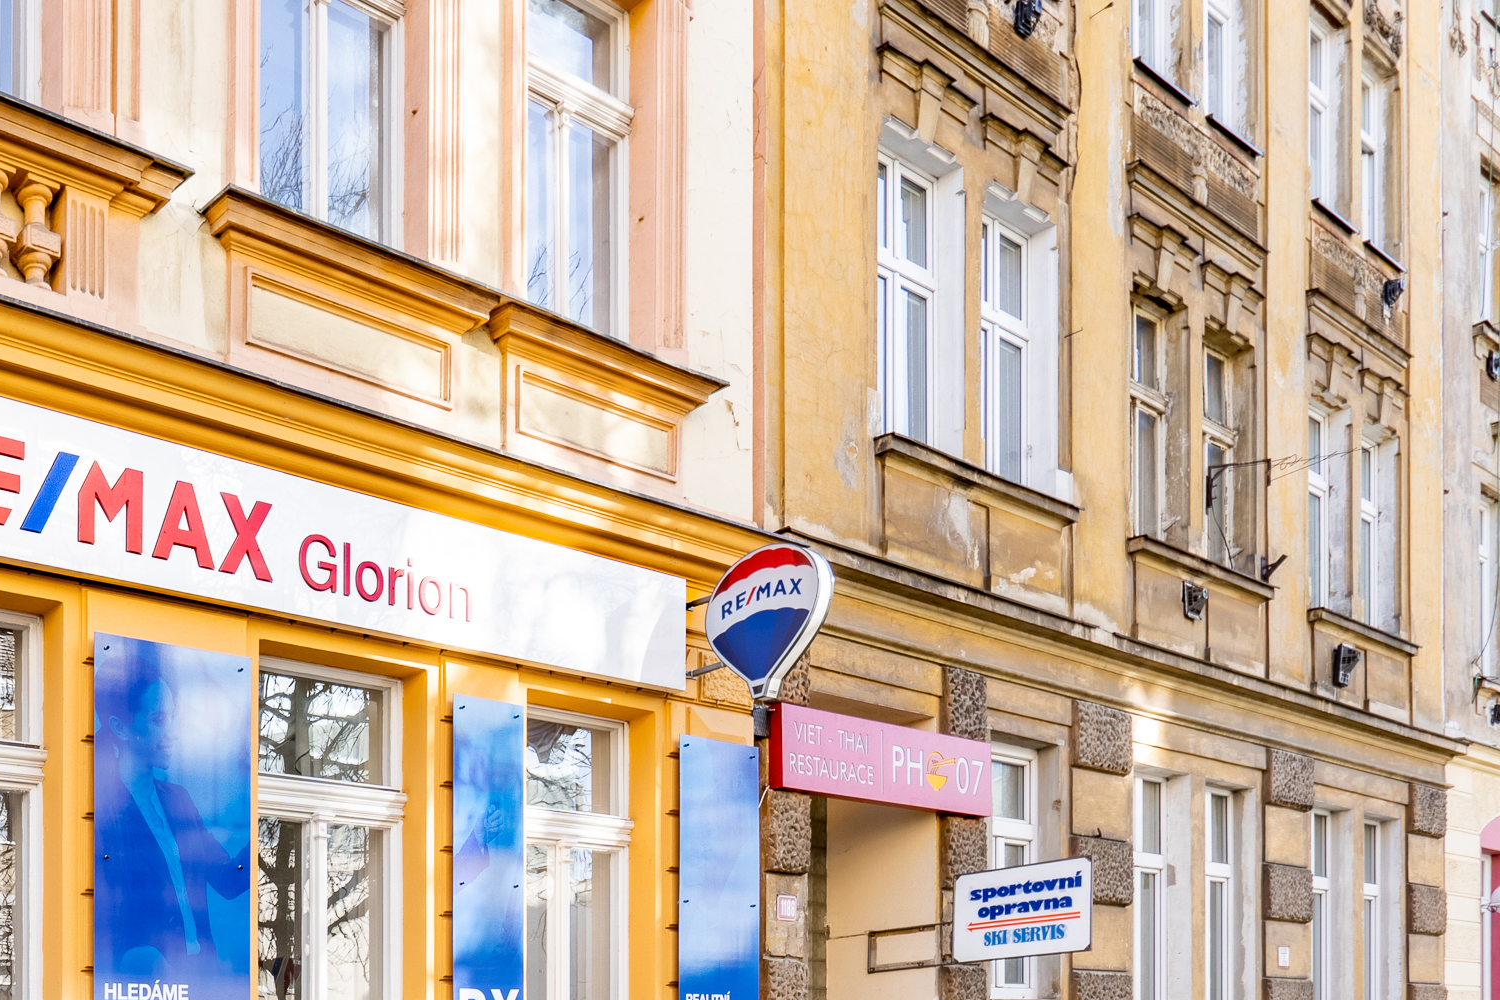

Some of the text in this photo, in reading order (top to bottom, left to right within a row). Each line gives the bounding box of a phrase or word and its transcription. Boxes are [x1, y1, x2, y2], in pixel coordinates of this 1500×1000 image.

[299, 534, 472, 622] Glorion
[722, 578, 802, 620] RE/MAX
[794, 721, 823, 745] VIET
[837, 730, 868, 753] THAI
[789, 752, 874, 786] RESTAURACE
[970, 870, 1083, 902] sportovní
[978, 896, 1072, 920] opravna
[984, 924, 1065, 946] SKI SERVIS
[104, 980, 189, 1000] HLEDÁME
